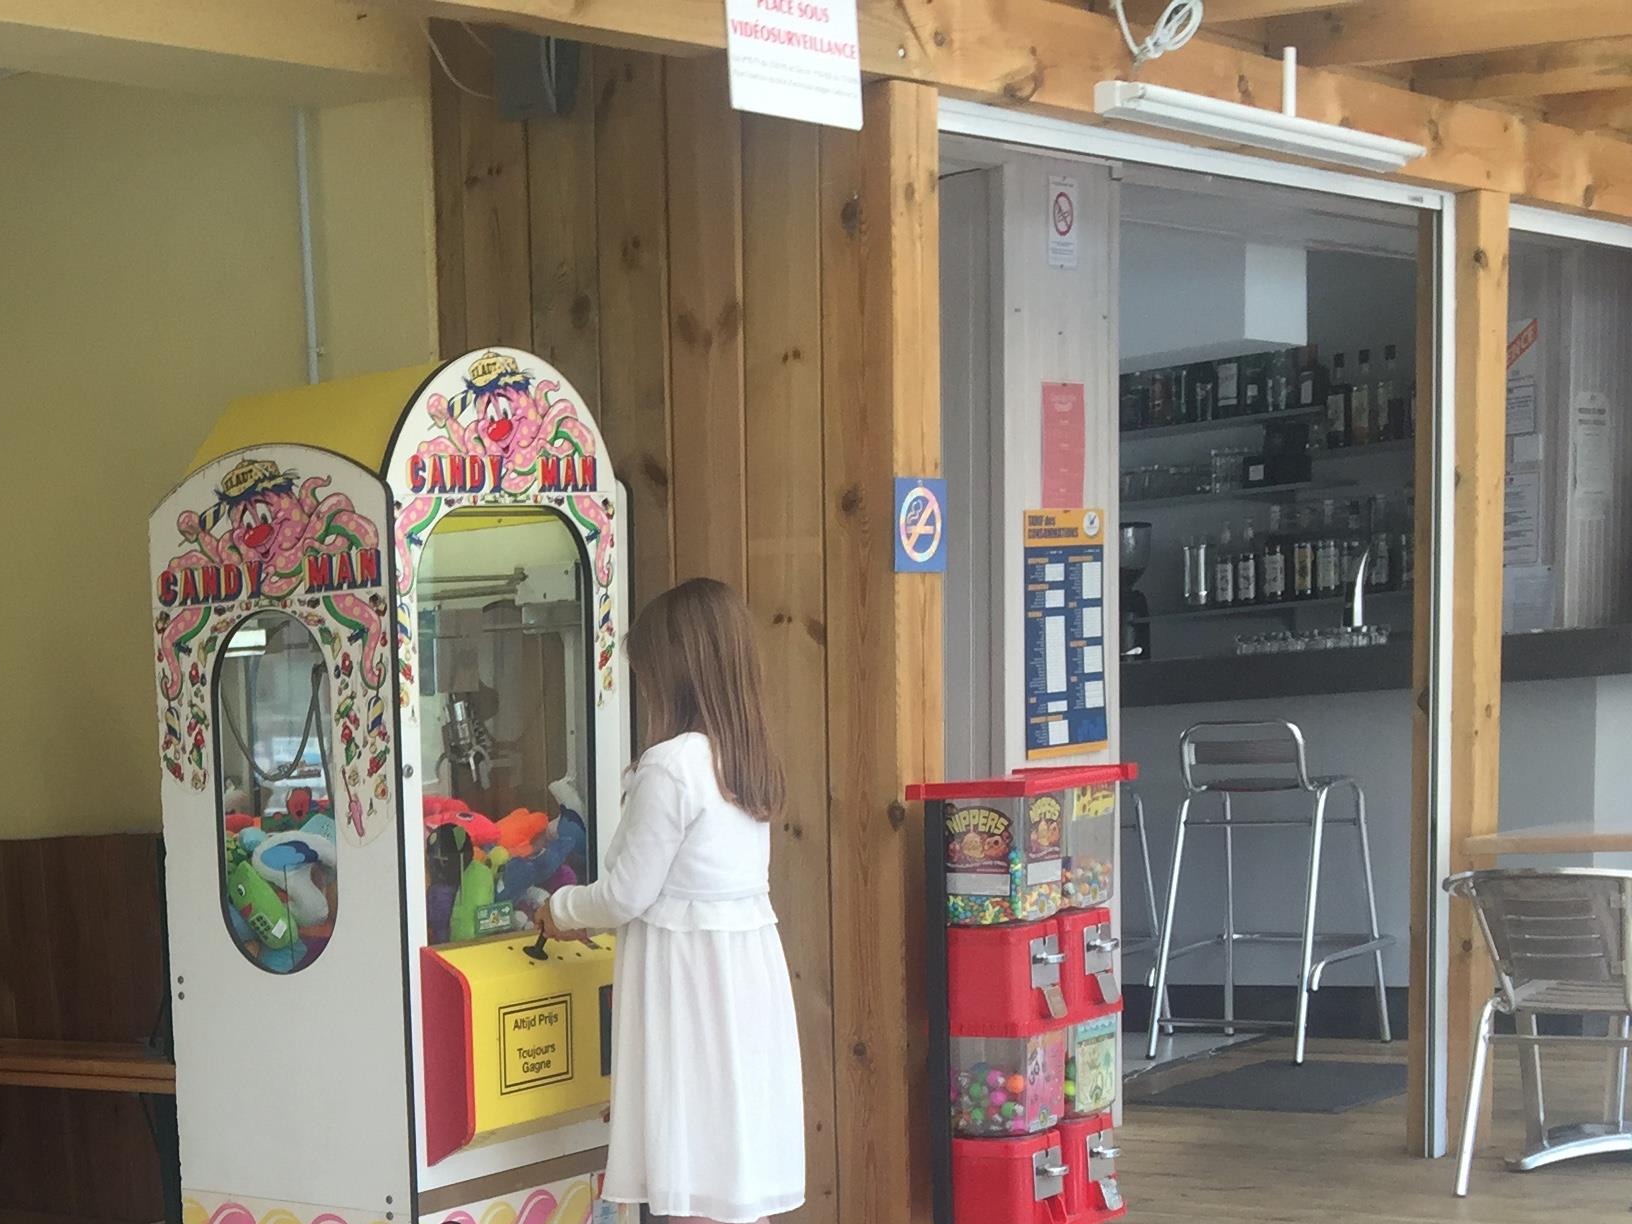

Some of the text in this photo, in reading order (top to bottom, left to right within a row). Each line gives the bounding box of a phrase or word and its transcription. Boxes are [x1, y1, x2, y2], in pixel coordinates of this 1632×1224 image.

[797, 2, 830, 23] SOUS
[730, 18, 857, 60] VIDÉOSURVEILLANCE
[406, 453, 598, 494] CANDY MAN
[157, 547, 382, 607] CANDY MAN
[945, 809, 1009, 834] NIPPERS
[513, 1012, 559, 1031] Altijd Prijs
[517, 1043, 556, 1060] Toujours
[522, 1058, 551, 1074] Gagne
